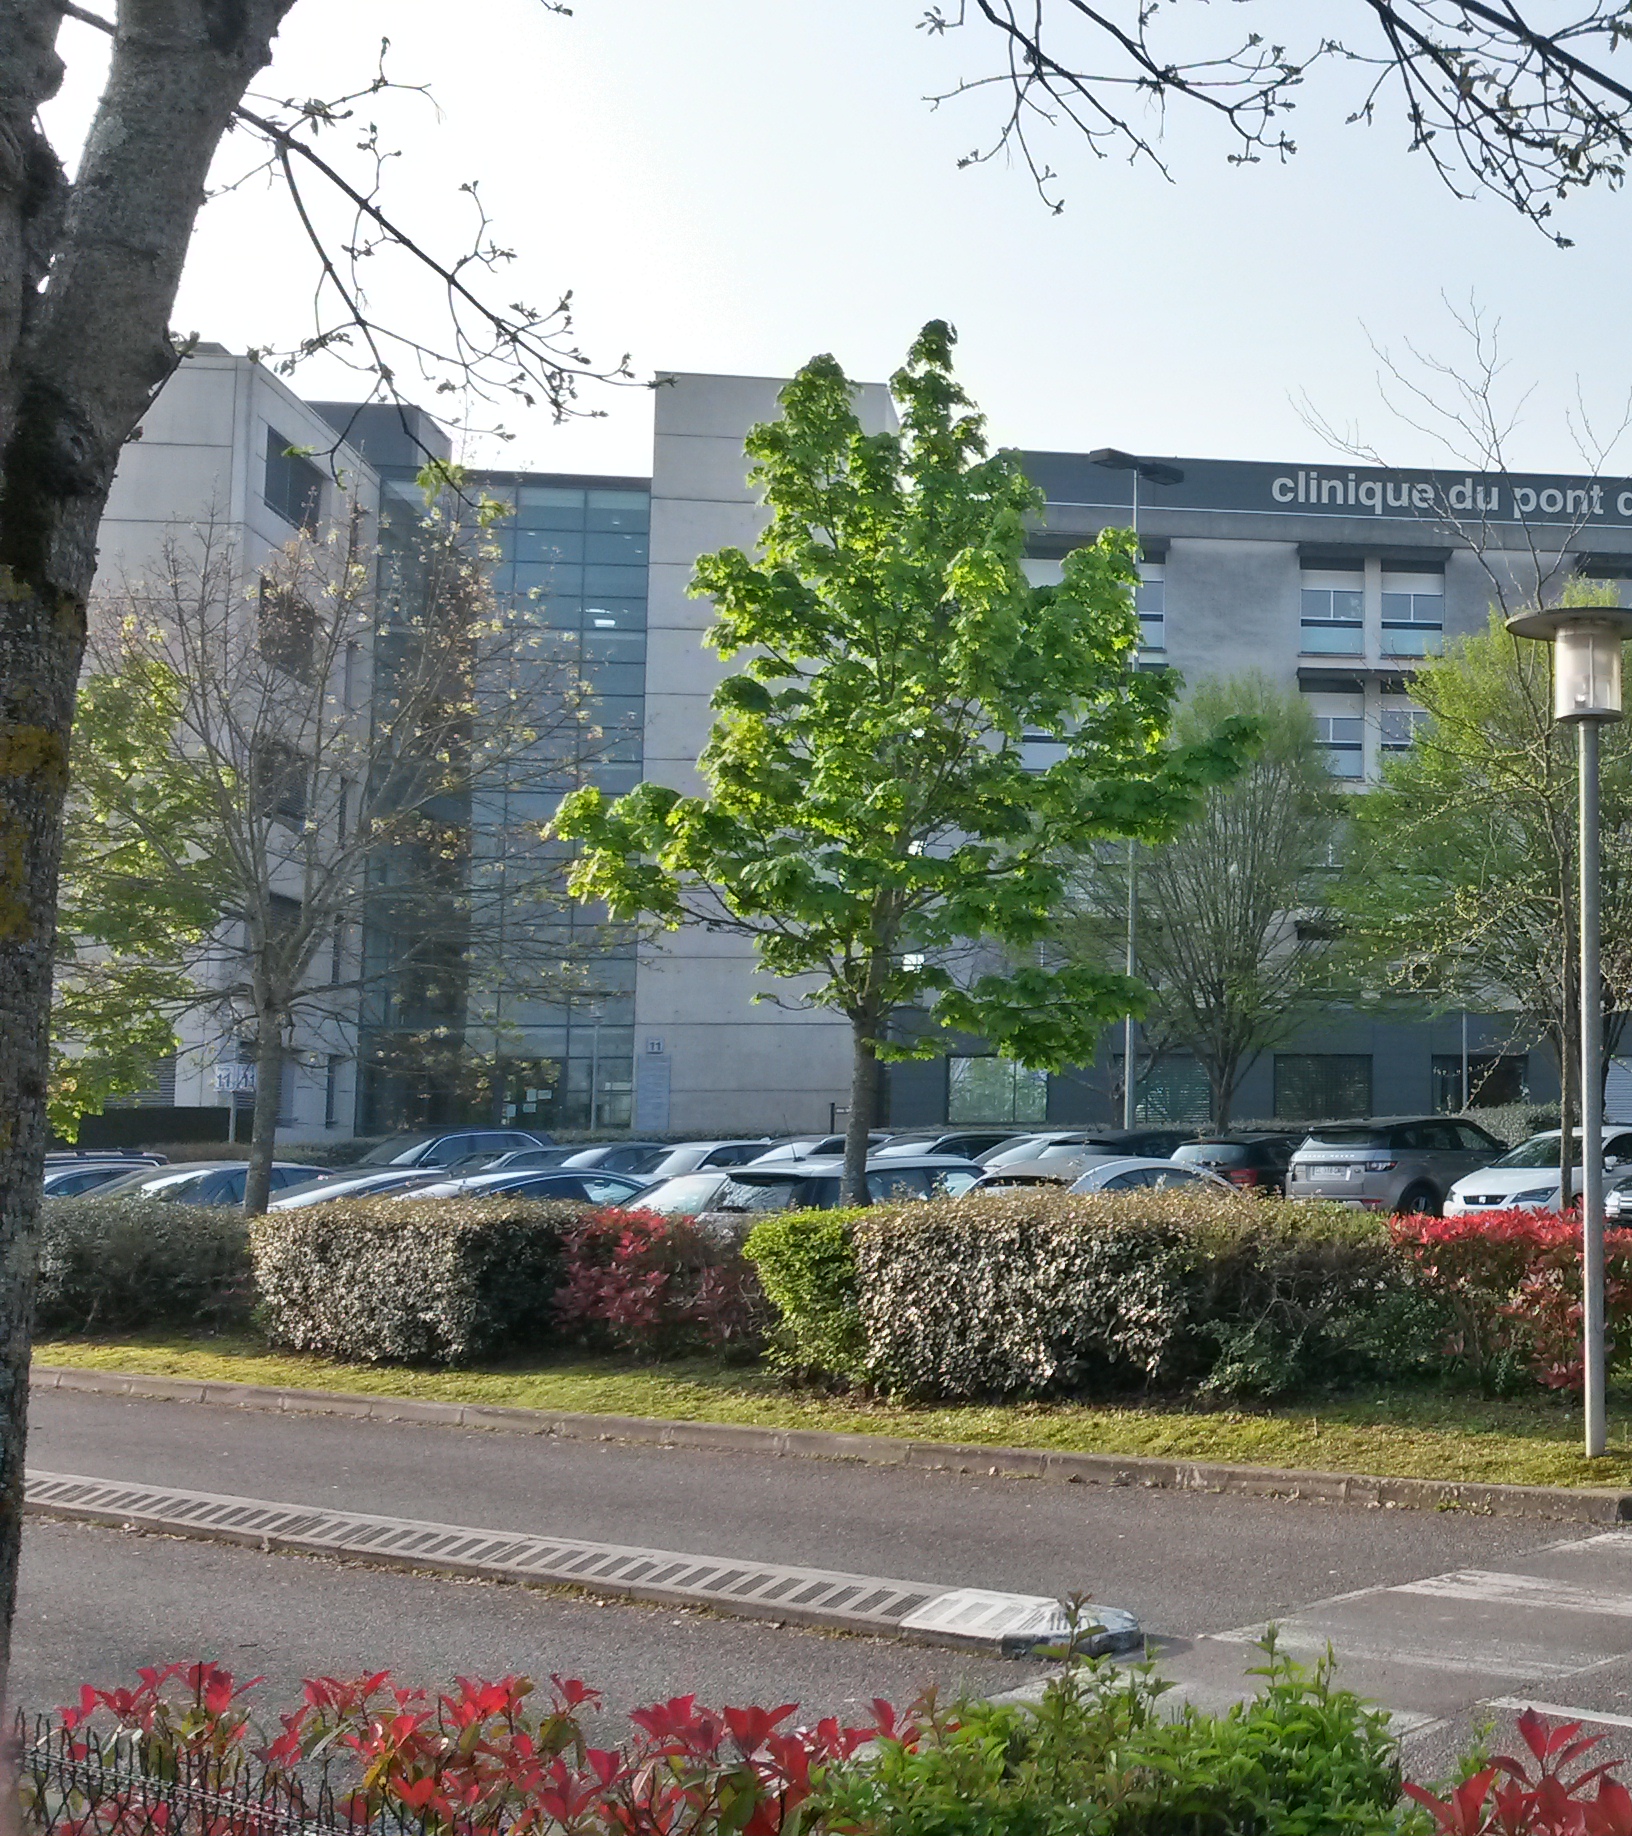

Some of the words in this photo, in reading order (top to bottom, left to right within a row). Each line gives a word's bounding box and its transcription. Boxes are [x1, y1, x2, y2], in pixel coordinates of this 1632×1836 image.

[1271, 470, 1435, 515] clinique
[1448, 477, 1500, 511] du
[1512, 484, 1605, 519] pont
